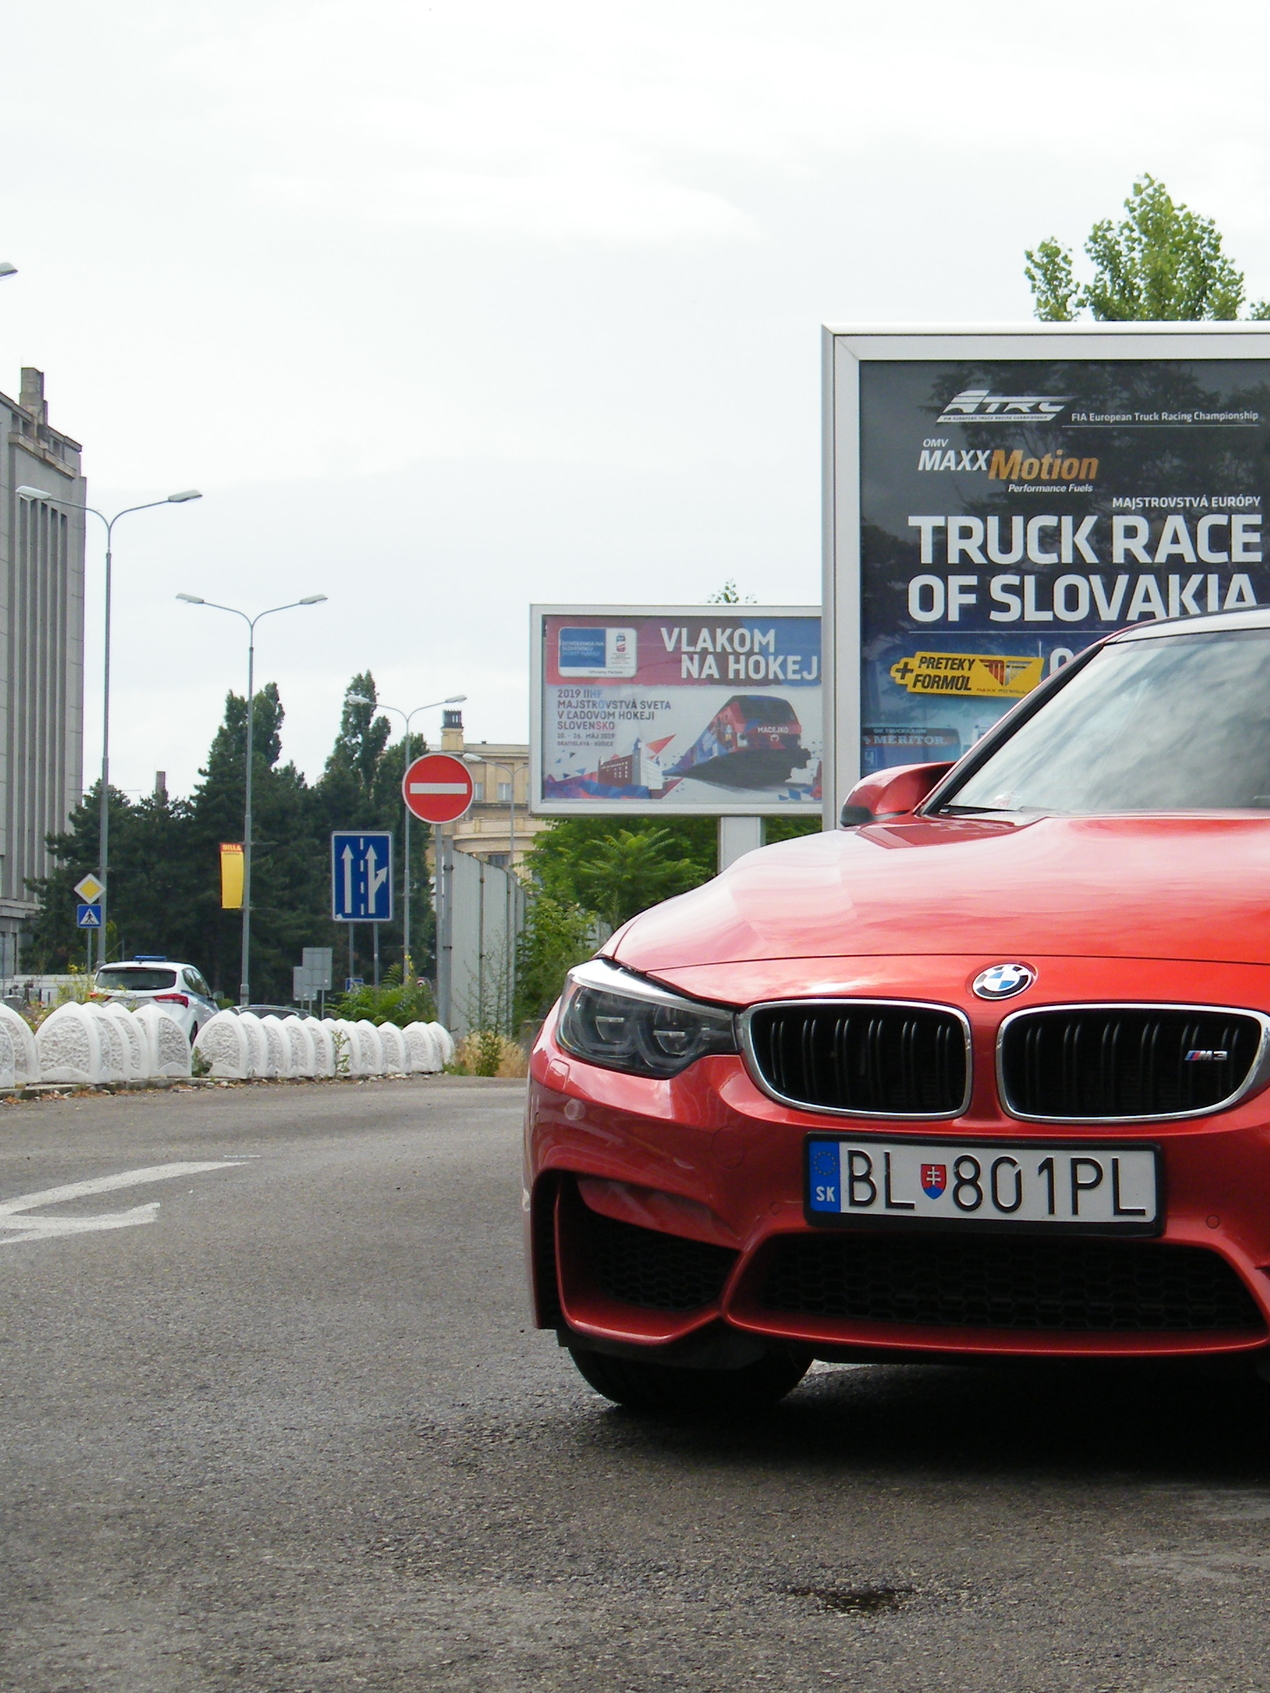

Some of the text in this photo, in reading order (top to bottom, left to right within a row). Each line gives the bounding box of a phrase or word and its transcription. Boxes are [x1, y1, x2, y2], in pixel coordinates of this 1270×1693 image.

[1071, 410, 1259, 423] FIA European Truck Racing Championship
[923, 438, 948, 447] OMV
[1008, 483, 1093, 494] Performance Fuels
[1112, 494, 1261, 510] MAJSTROVSTVÁ EURÓPY
[908, 514, 1263, 565] TRUCK RACE
[908, 574, 1257, 622] OF SLOVAKIA
[660, 627, 776, 653] VLAKOM
[680, 654, 818, 680] NA HOKEJ
[917, 656, 976, 671] PRETEKY
[912, 673, 973, 691] FORMÚL
[557, 689, 603, 698] 2019 IIHF
[557, 699, 672, 710] MAJSTROVSTVÁ SVETA
[557, 710, 655, 720] V ĽADOVOM HOKEJI
[557, 721, 615, 730] SLOVENSKO
[873, 735, 944, 745] MERITOR
[815, 1185, 836, 1203] SK
